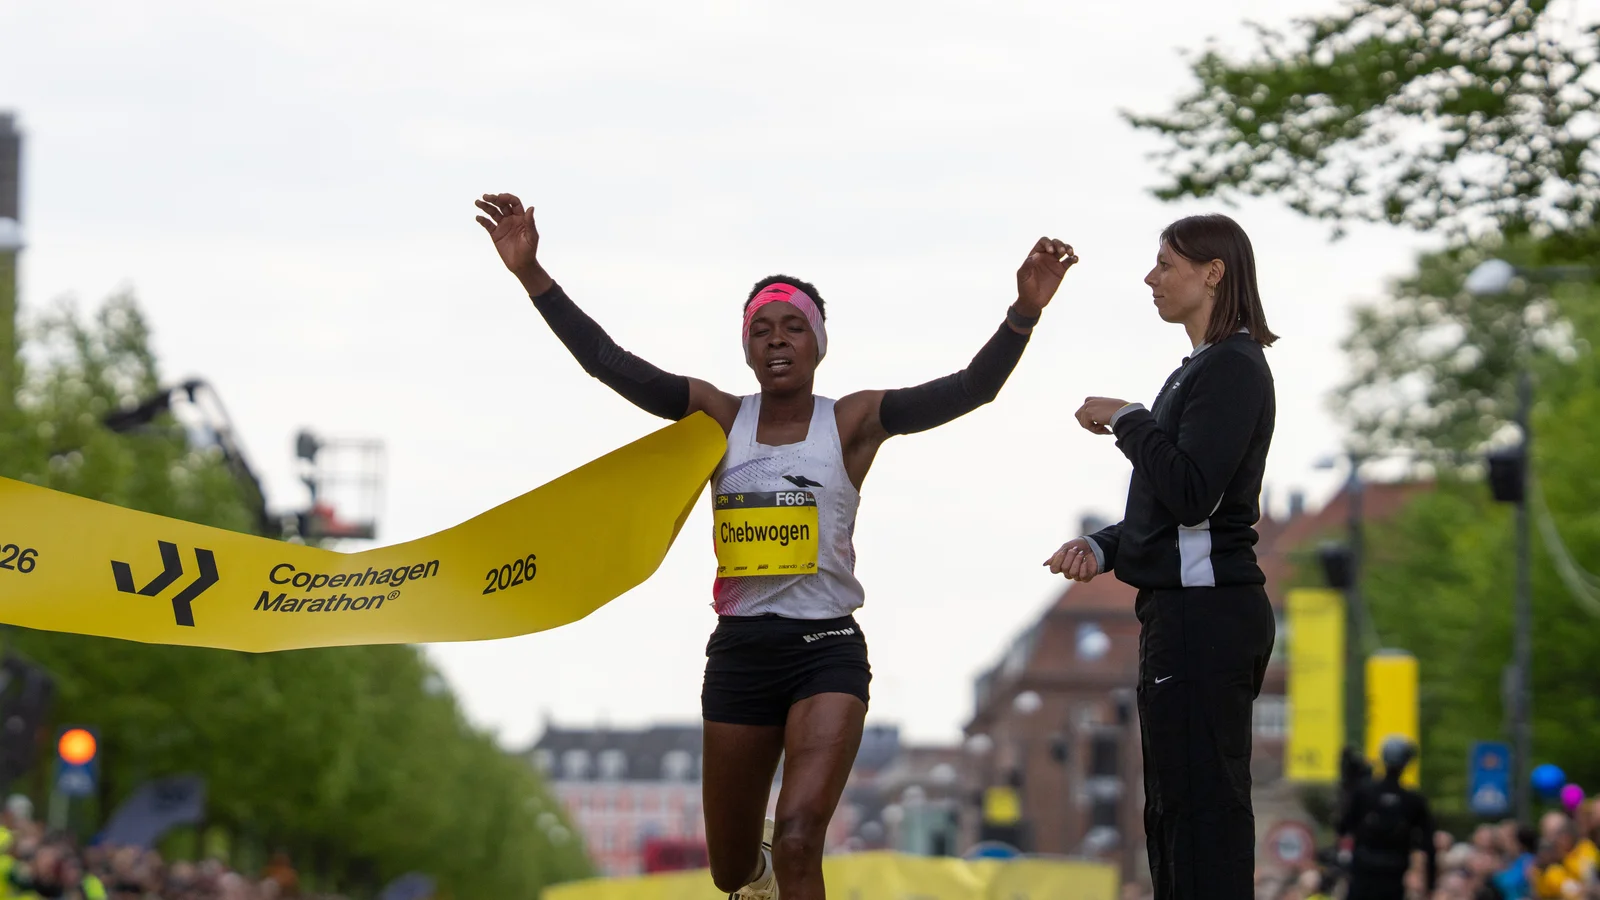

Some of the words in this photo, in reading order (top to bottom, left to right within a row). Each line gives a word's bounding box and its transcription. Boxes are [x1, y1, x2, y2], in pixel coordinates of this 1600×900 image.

[775, 492, 805, 506] F66
[720, 521, 810, 546] Chebwogen
[0, 543, 39, 574] 26
[482, 553, 537, 595] 2026
[268, 559, 440, 592] Copenhagen
